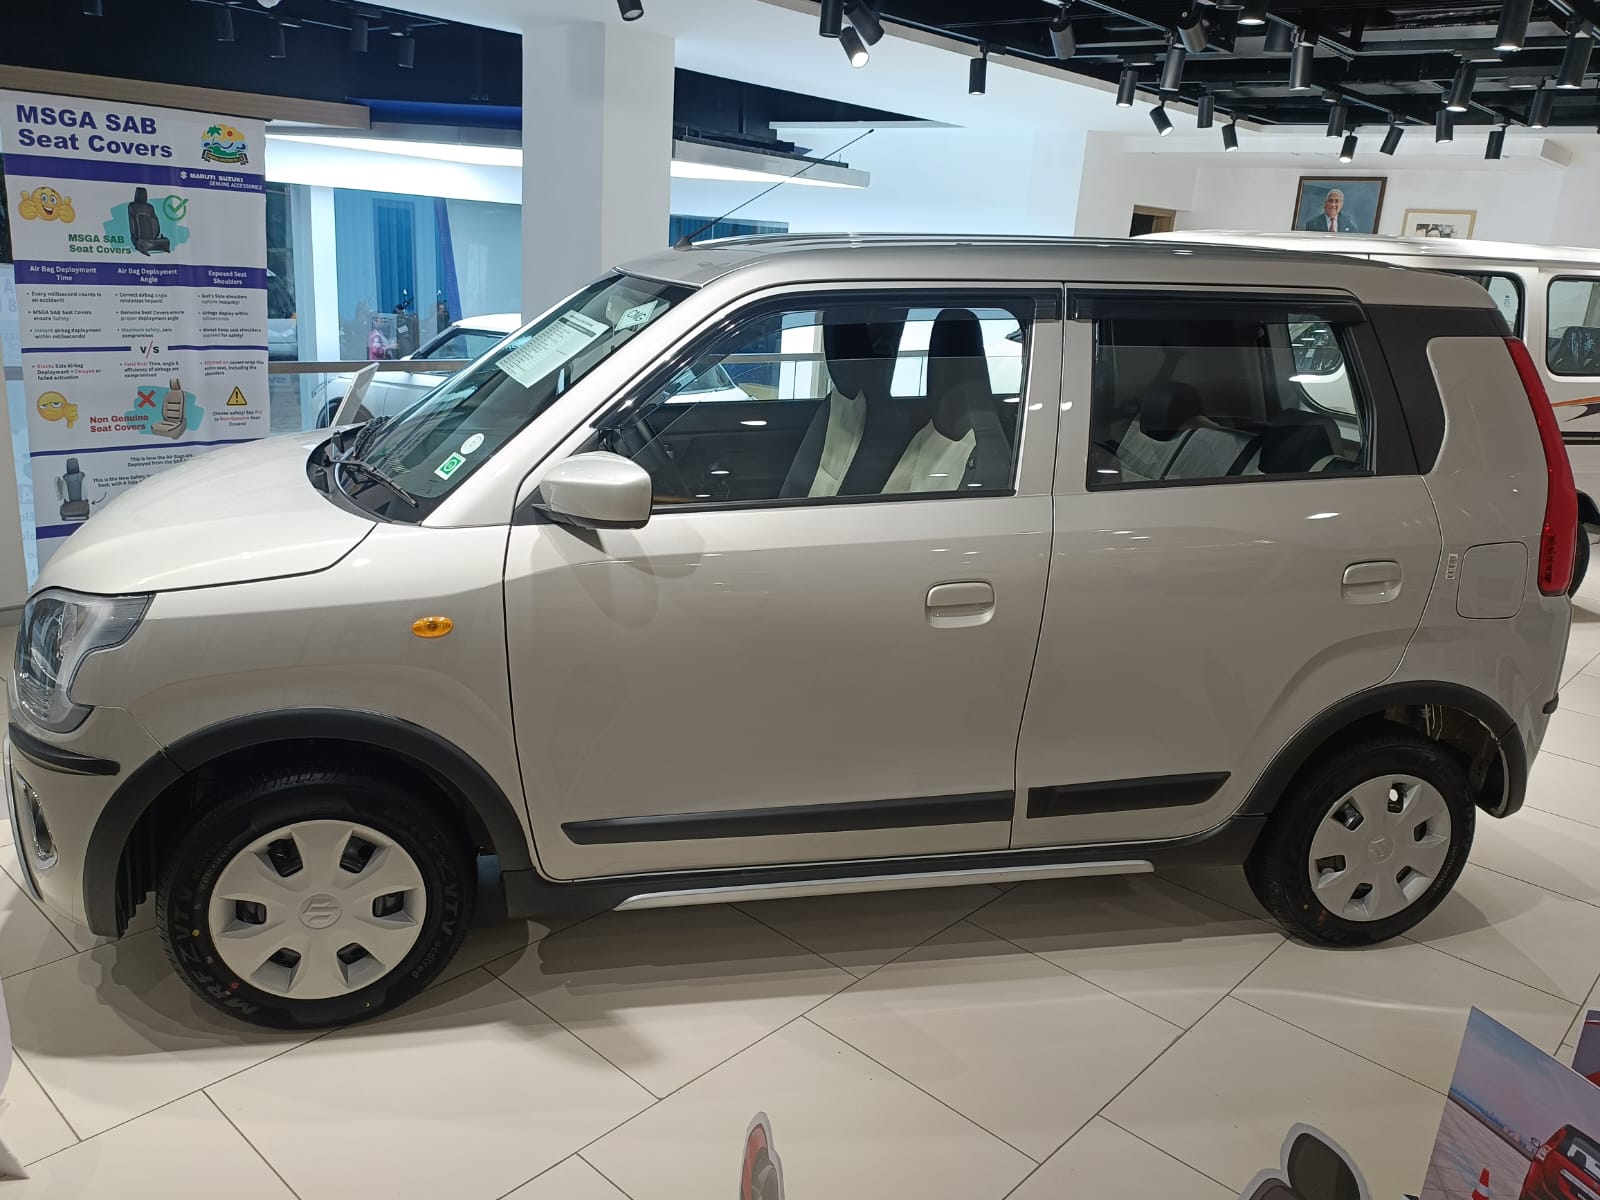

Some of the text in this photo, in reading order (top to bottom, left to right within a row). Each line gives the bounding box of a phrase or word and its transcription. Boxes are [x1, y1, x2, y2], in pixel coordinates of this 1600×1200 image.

[16, 104, 157, 135] MSGA SAB
[18, 129, 172, 158] Seat Covers
[190, 172, 216, 180] MARUTI
[230, 182, 262, 190] ACCESSORIES
[68, 234, 125, 244] MSGA SAB
[69, 244, 132, 254] Seat Covers
[56, 266, 97, 274] Deployment
[141, 268, 178, 276] Deployment
[626, 309, 647, 322] CNG
[89, 414, 149, 424] Non Genuine
[90, 423, 146, 433] Seat Covers
[191, 968, 260, 1017] MRF
